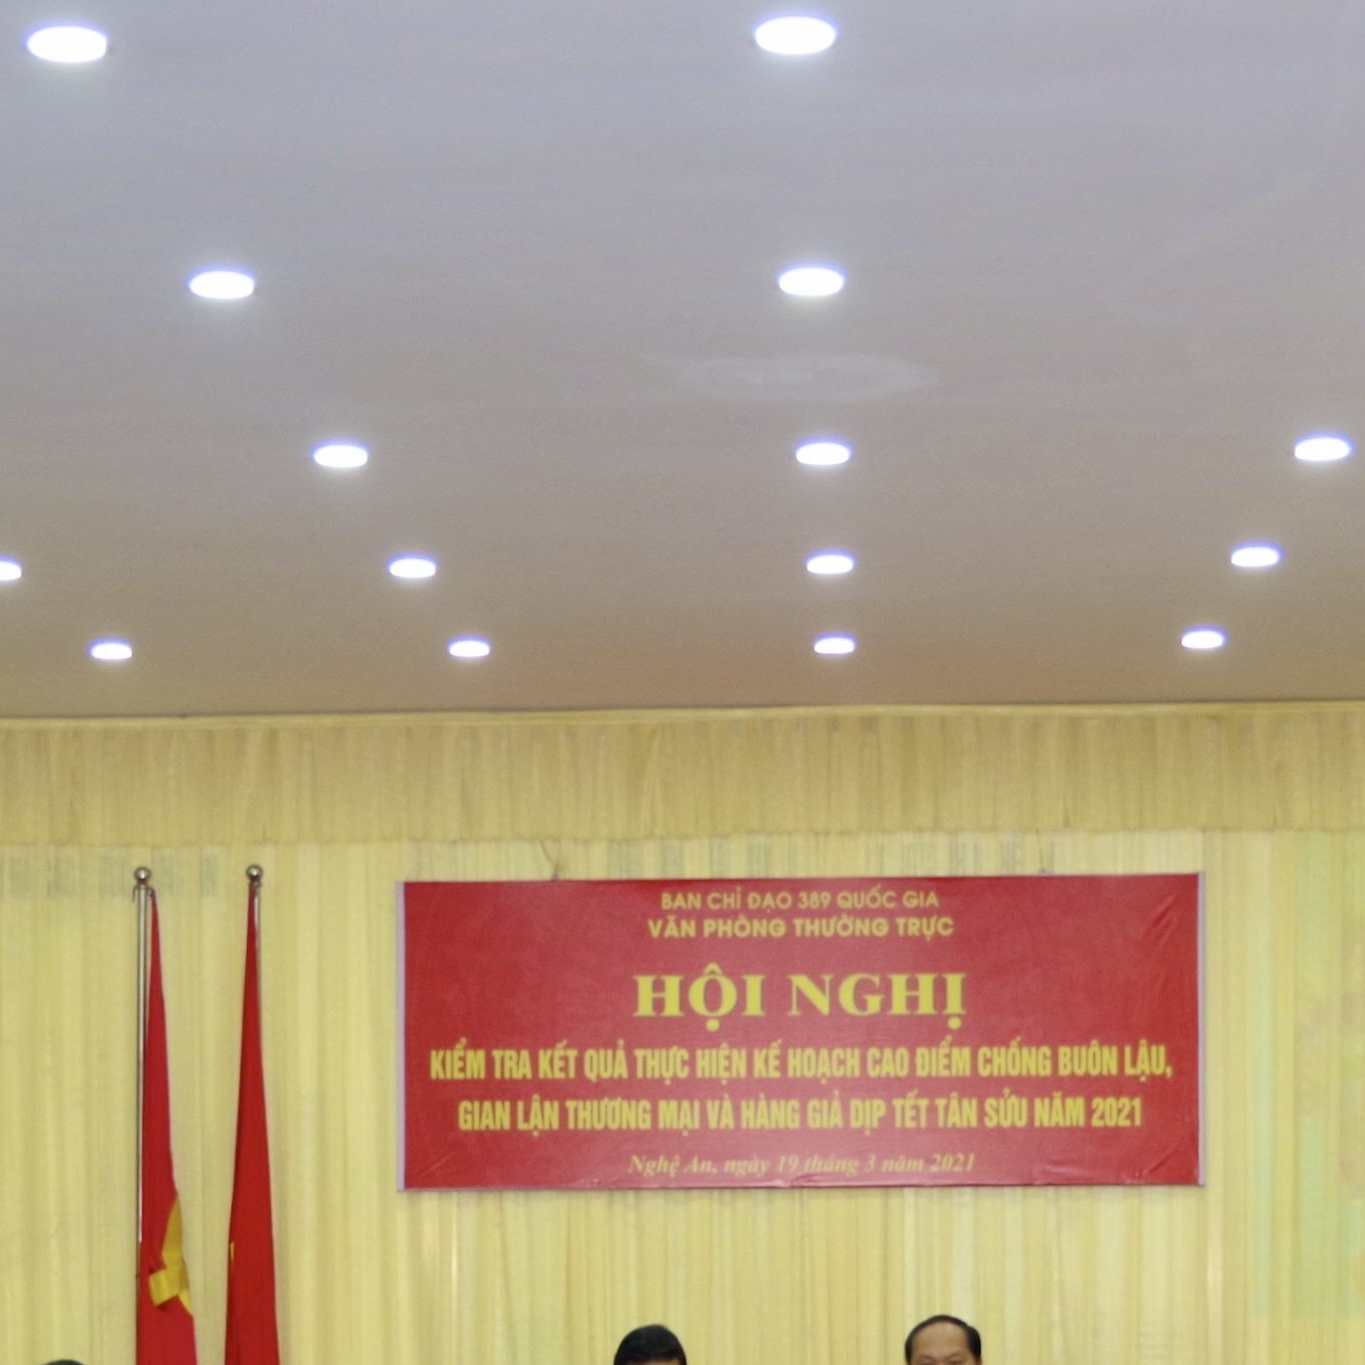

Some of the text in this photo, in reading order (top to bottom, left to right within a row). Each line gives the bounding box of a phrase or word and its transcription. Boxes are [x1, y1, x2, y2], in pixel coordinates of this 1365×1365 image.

[661, 884, 939, 913] BAN CHỈ ĐẠO 389 QUỐC GIA
[648, 914, 954, 942] VĂN PHÒNG THƯỜNG TRỰC
[633, 962, 967, 1032] HỘI NGHỊ
[430, 1035, 1173, 1085] KIỂM TRA KẾT QUẢ THỰC HIỆN KẾ HOẠCH CAO ĐIỂM CHỐNG BUÔN LẬU,
[458, 1088, 1142, 1136] GIAN LẬN THƯƠNG MẠI VÀ HÀNG GIẢ DỊP TẾT TÂN SỬU NĂM 2021
[628, 1153, 976, 1178] Nghệ An, ngày 19 tháng 3 năm 2021
